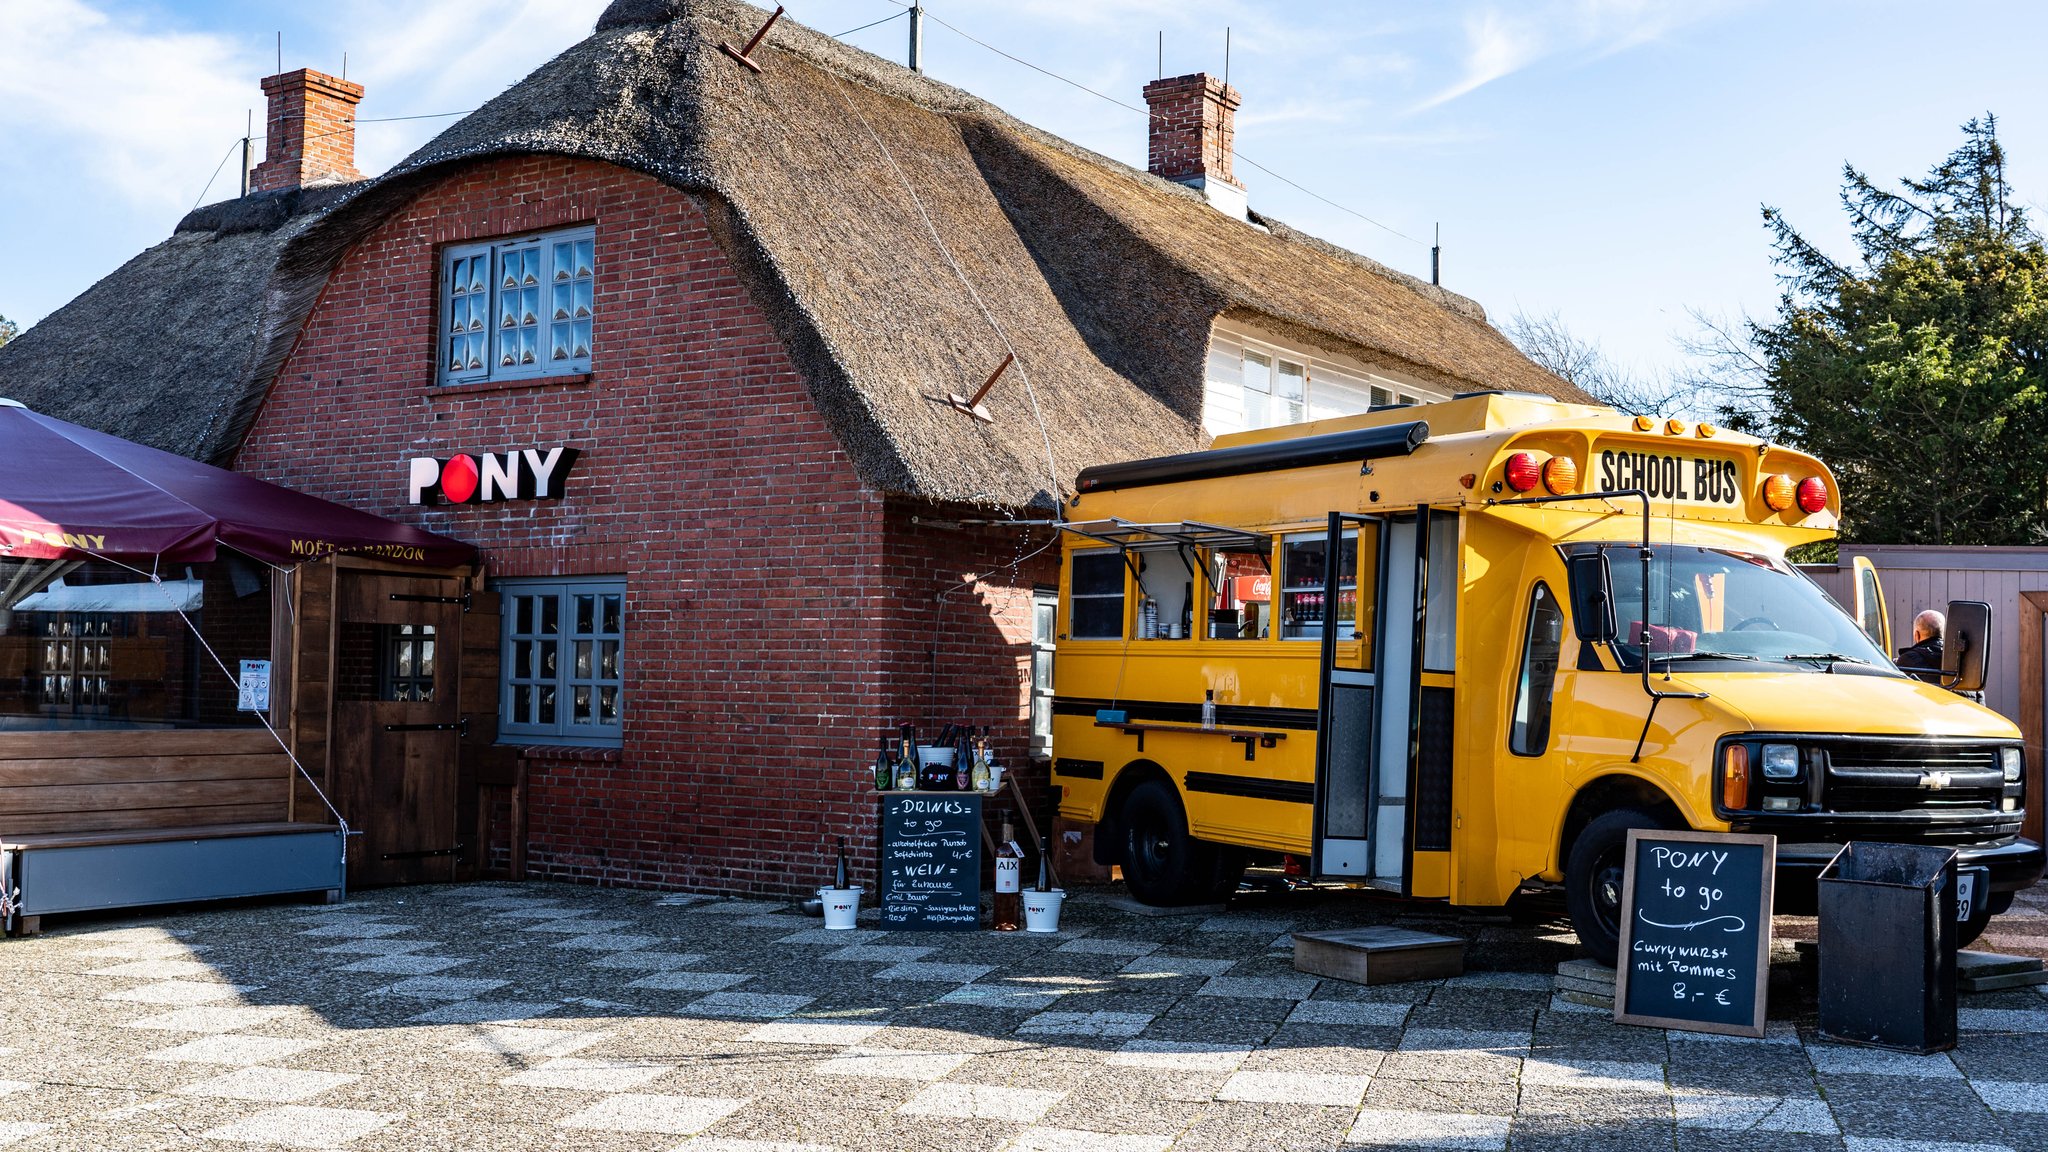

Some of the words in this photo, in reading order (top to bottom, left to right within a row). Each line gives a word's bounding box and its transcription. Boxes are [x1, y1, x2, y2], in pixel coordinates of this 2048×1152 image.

[409, 447, 566, 504] PONY
[1601, 450, 1687, 499] SCHOOL
[1694, 458, 1736, 504] BUS
[21, 529, 105, 550] PONY
[901, 799, 963, 814] DRINKS
[903, 818, 917, 828] to
[924, 820, 942, 832] go
[905, 863, 946, 877] WEIN
[998, 861, 1018, 870] AIX
[1650, 846, 1729, 875] PONY
[892, 879, 907, 890] für
[911, 879, 954, 889] Zuhause
[1661, 878, 1686, 898] to
[1698, 886, 1723, 911] go
[1637, 960, 1664, 973] mit
[1668, 960, 1737, 980] Pommes
